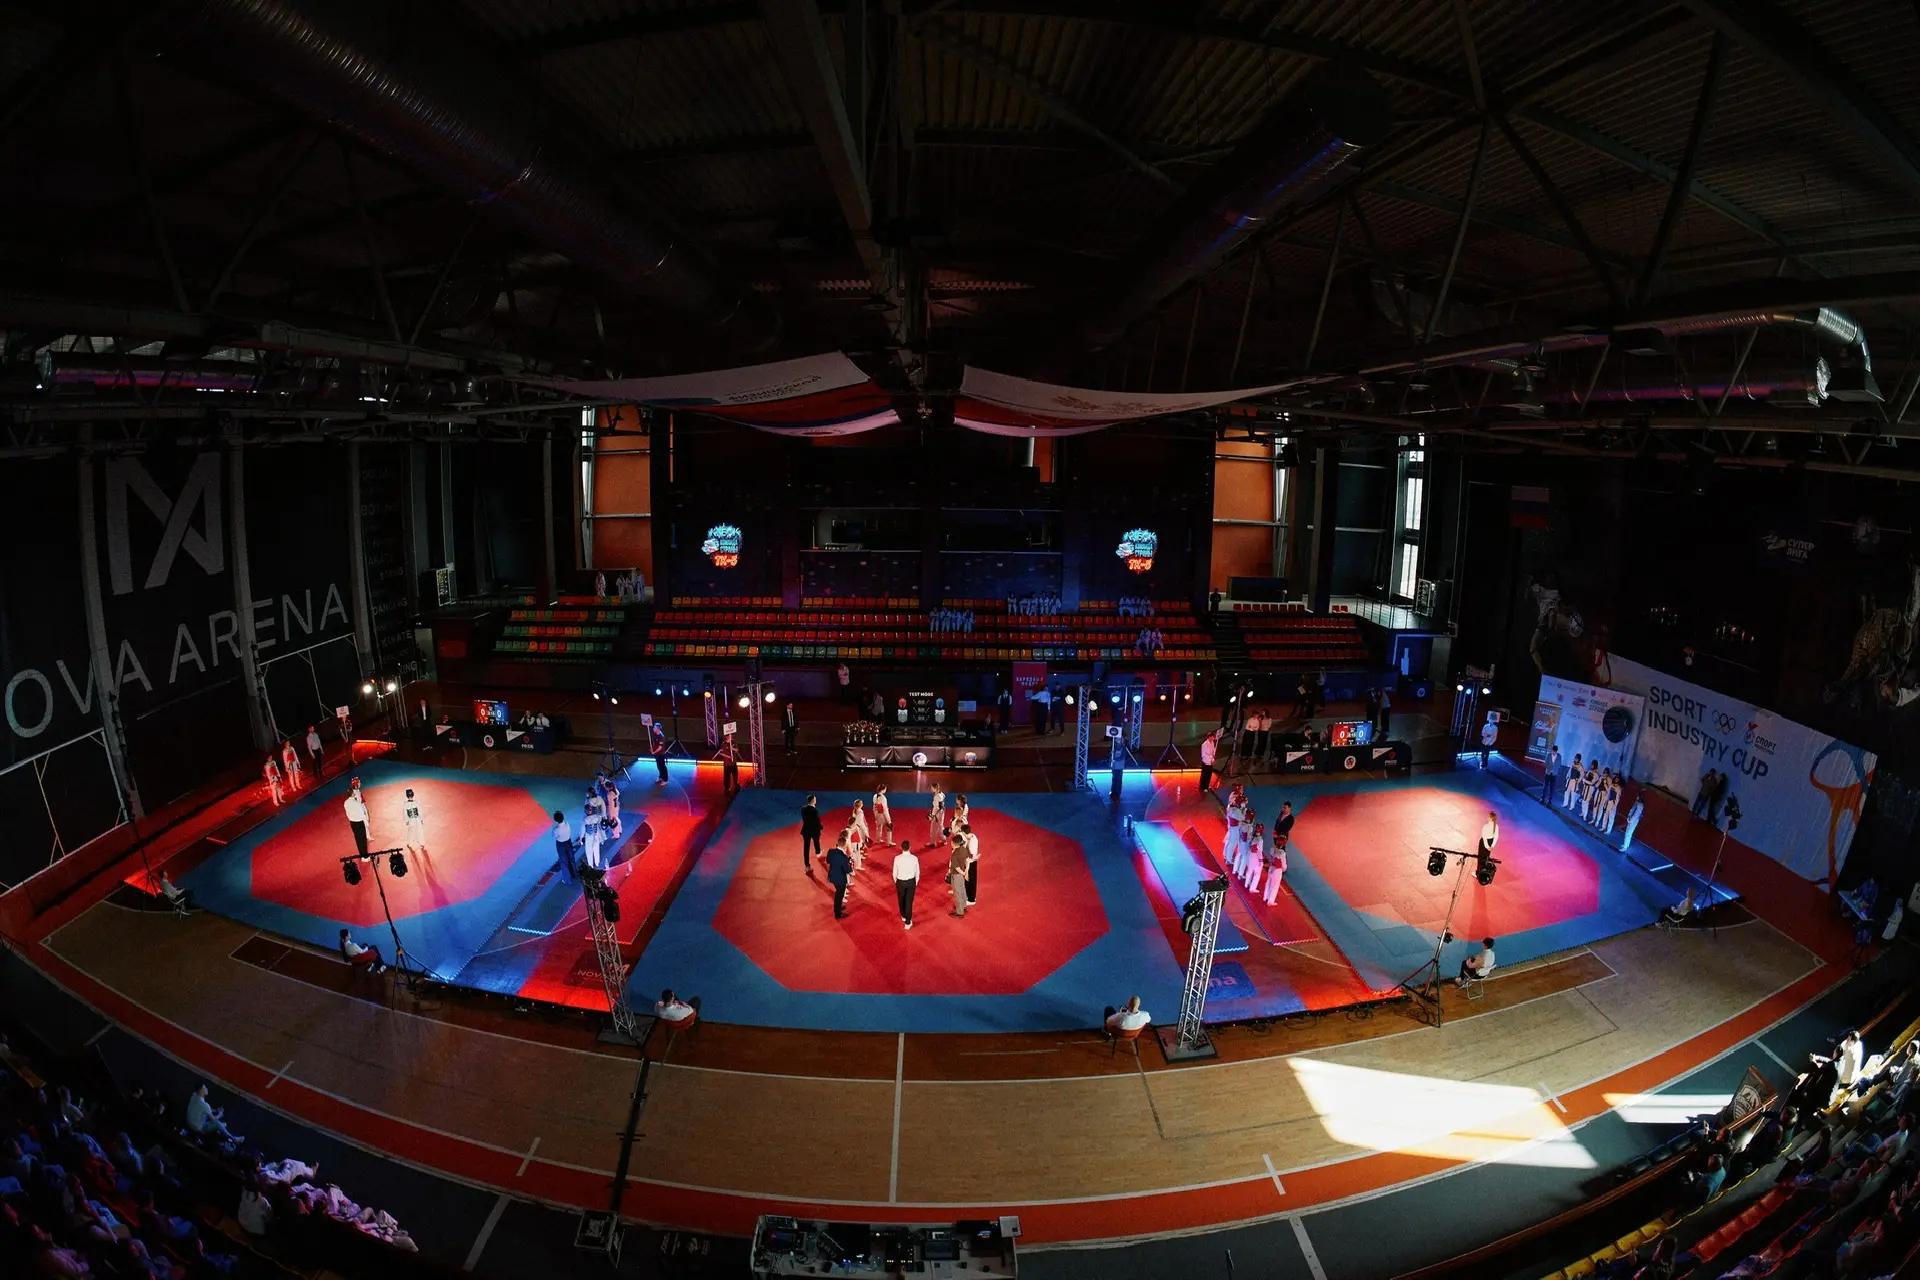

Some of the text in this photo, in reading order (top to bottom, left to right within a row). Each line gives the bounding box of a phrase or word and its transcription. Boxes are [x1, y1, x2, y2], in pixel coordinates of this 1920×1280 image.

[168, 582, 349, 684] ARENA
[1649, 686, 1707, 722] SPORT
[1339, 730, 1345, 739] 0
[1358, 729, 1364, 738] 0
[1647, 709, 1769, 780] INDUSTRY CUP
[1754, 735, 1777, 751] СПОРТ
